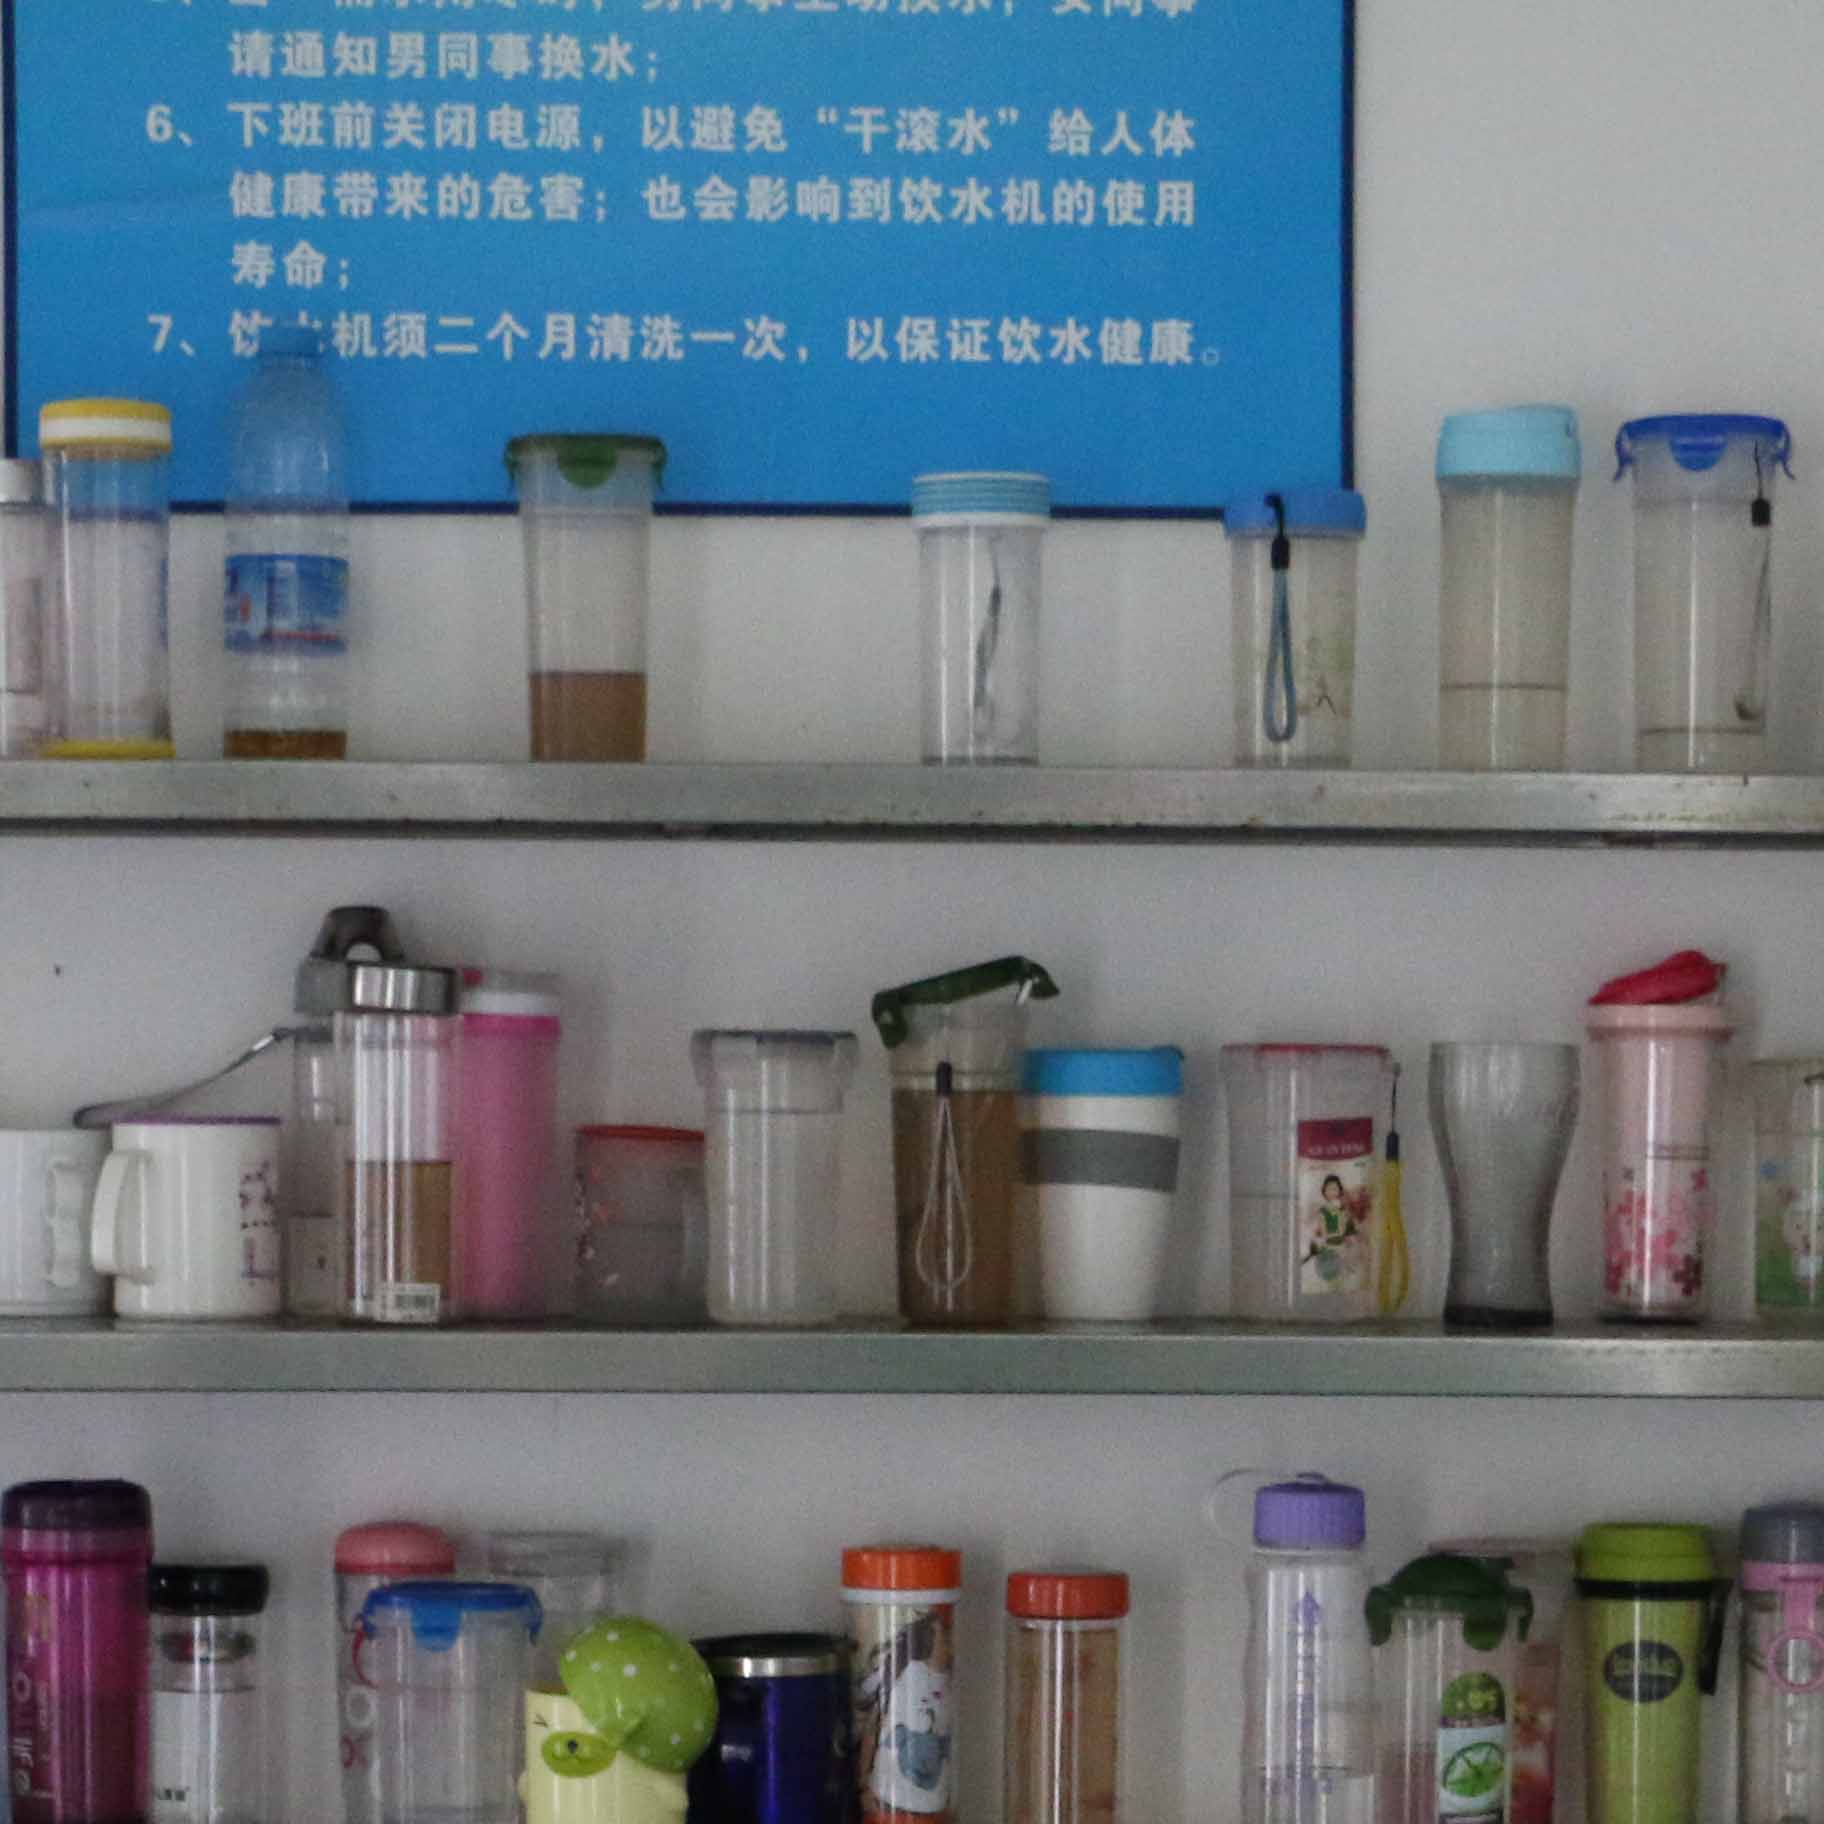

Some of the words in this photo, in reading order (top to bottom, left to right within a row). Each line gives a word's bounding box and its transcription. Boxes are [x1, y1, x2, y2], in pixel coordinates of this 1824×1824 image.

[229, 30, 658, 81] 请通知男同事换水；
[231, 240, 350, 290] 寿命；
